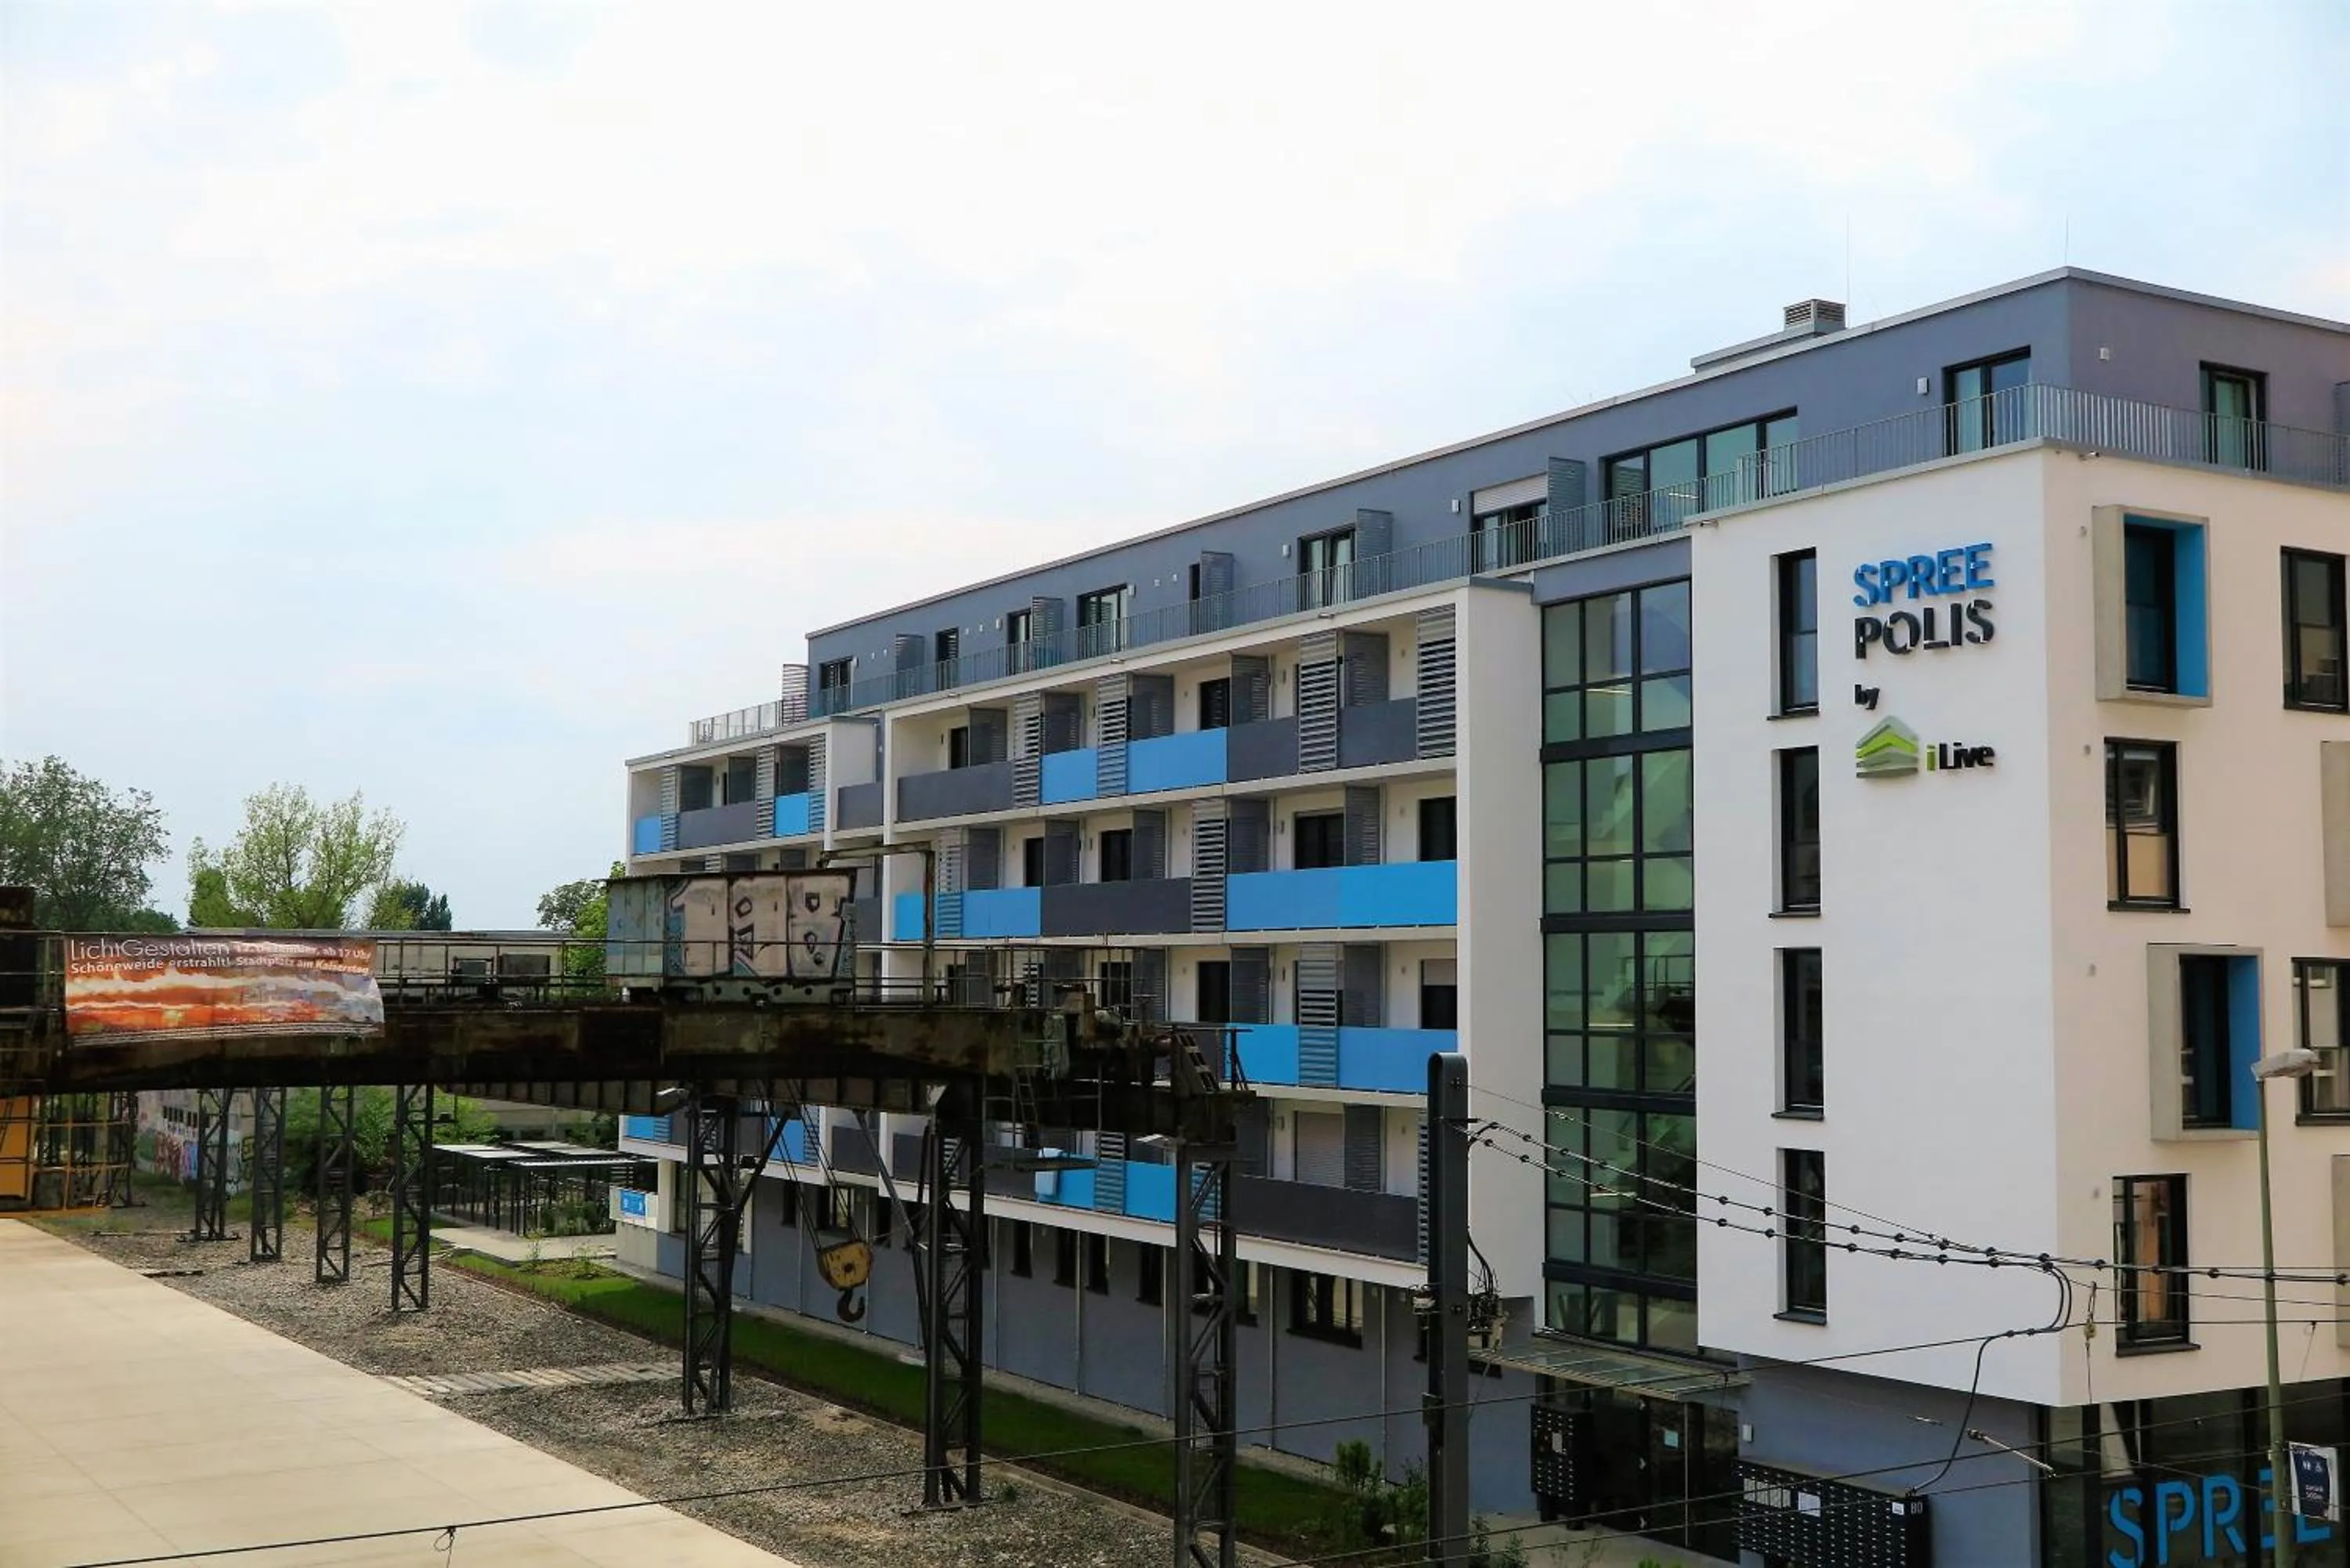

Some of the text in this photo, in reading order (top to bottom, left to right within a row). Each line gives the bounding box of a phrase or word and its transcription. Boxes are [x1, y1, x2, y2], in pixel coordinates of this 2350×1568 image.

[1853, 543, 1994, 607] SPREE
[1854, 599, 1994, 659] POLIS
[1854, 684, 1880, 710] by
[1926, 742, 1995, 771] iLive
[71, 938, 230, 961] LichtGestalten
[71, 957, 164, 974] Schöneweide
